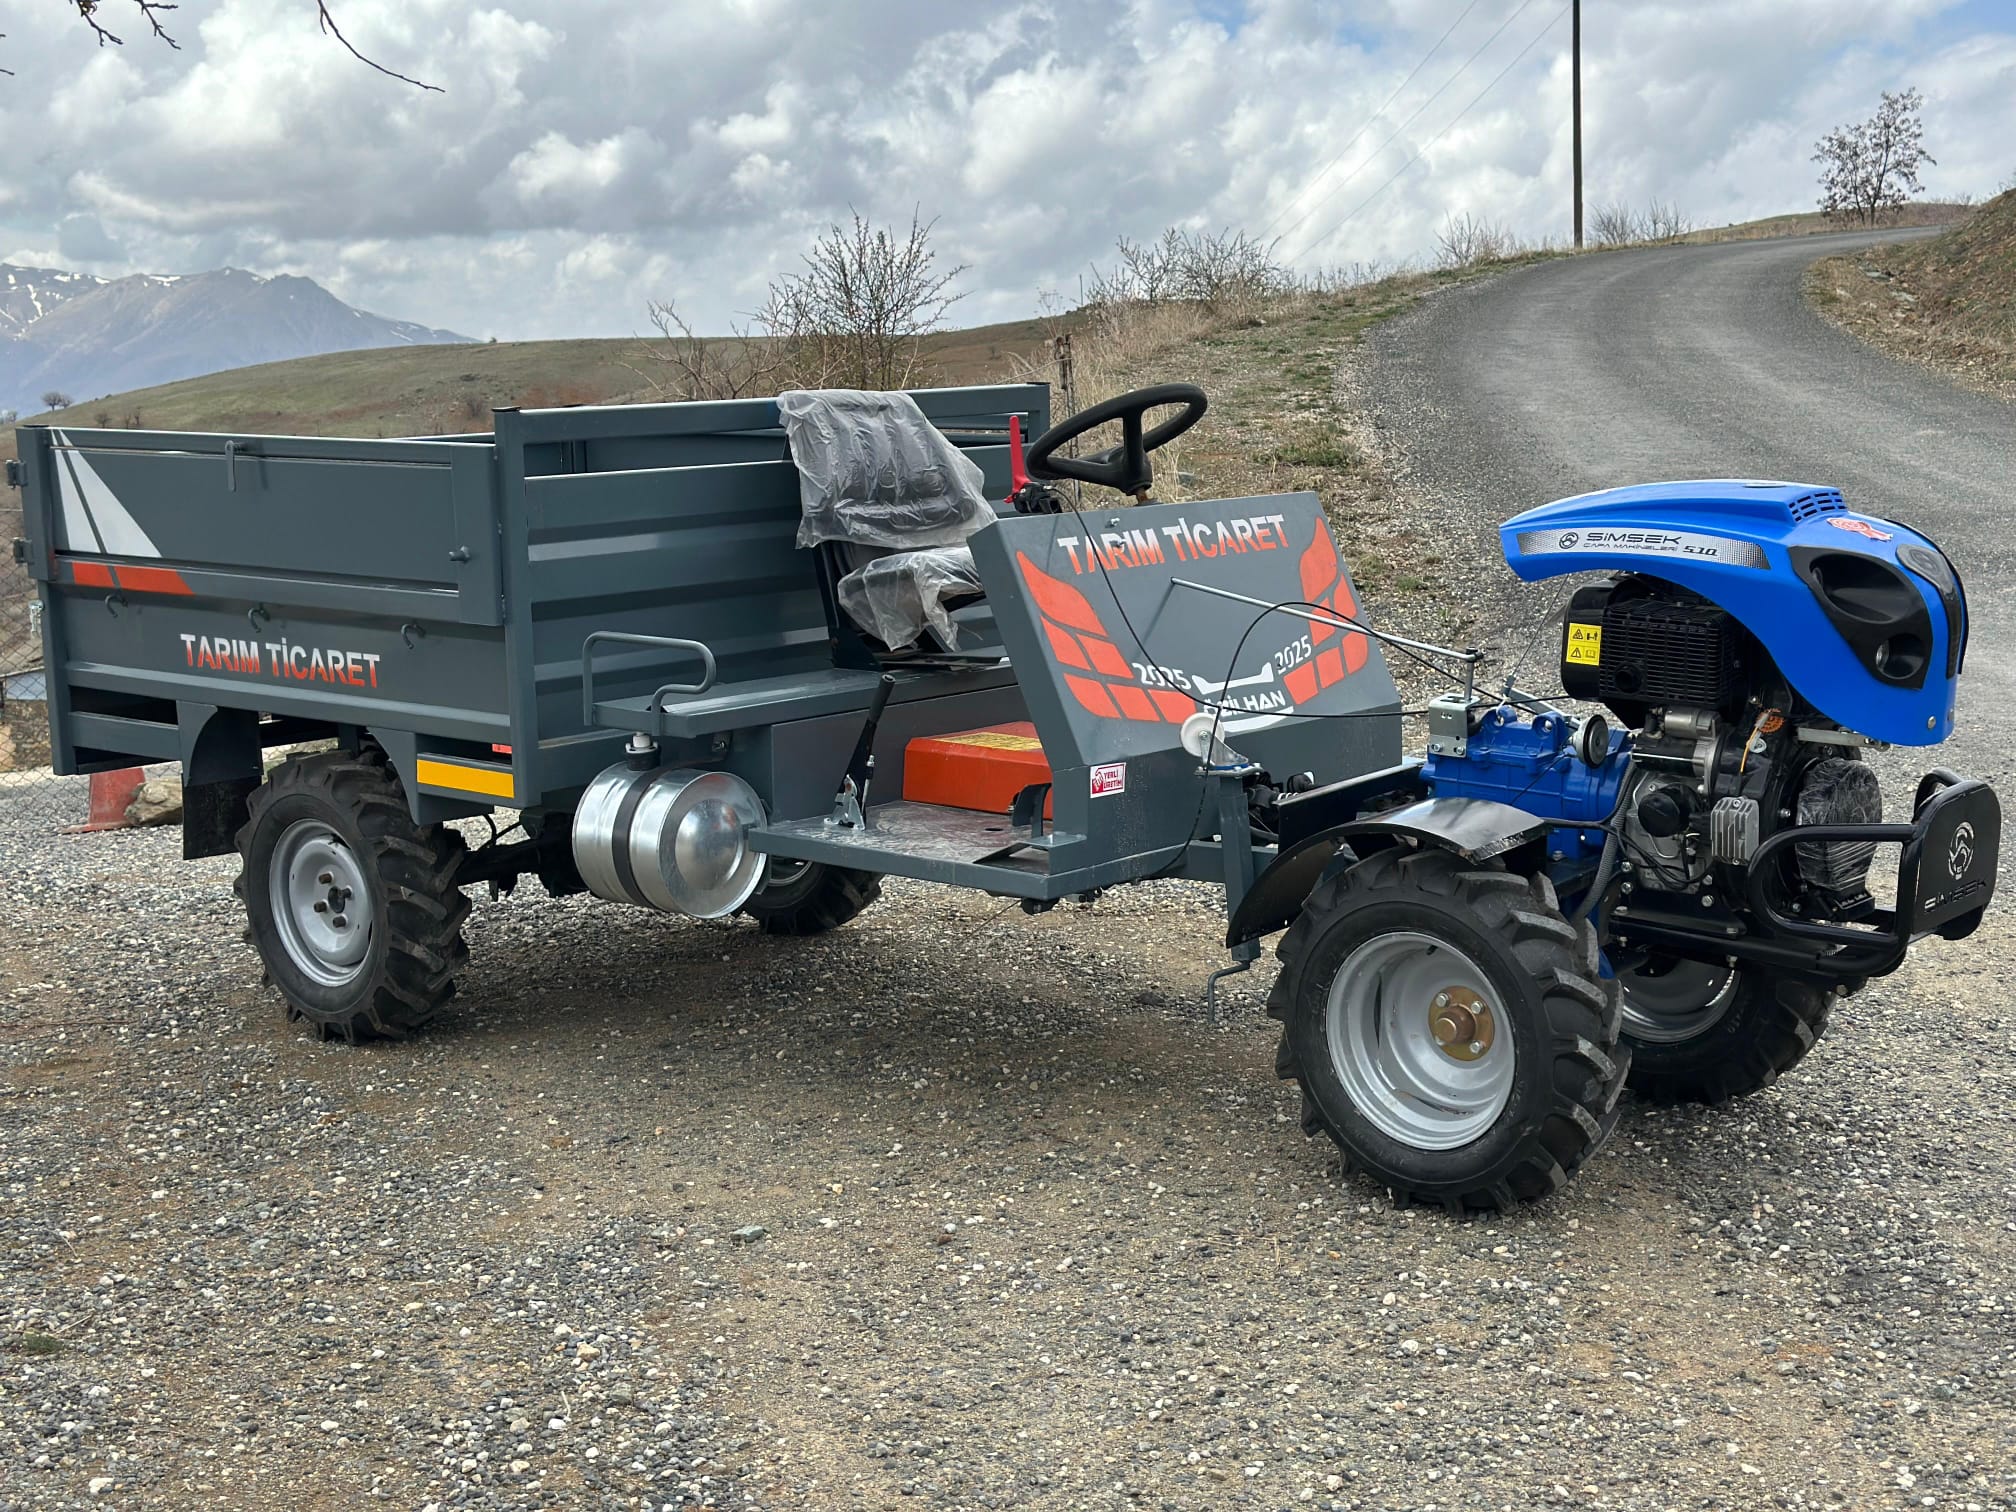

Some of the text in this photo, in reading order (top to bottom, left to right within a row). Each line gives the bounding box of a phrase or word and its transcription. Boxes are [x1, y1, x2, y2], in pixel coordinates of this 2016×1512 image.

[1057, 528, 1165, 576] TARIM
[180, 633, 381, 689] TARIM TİCARET
[1131, 662, 1192, 690] 2025
[1274, 634, 1312, 675] 2025
